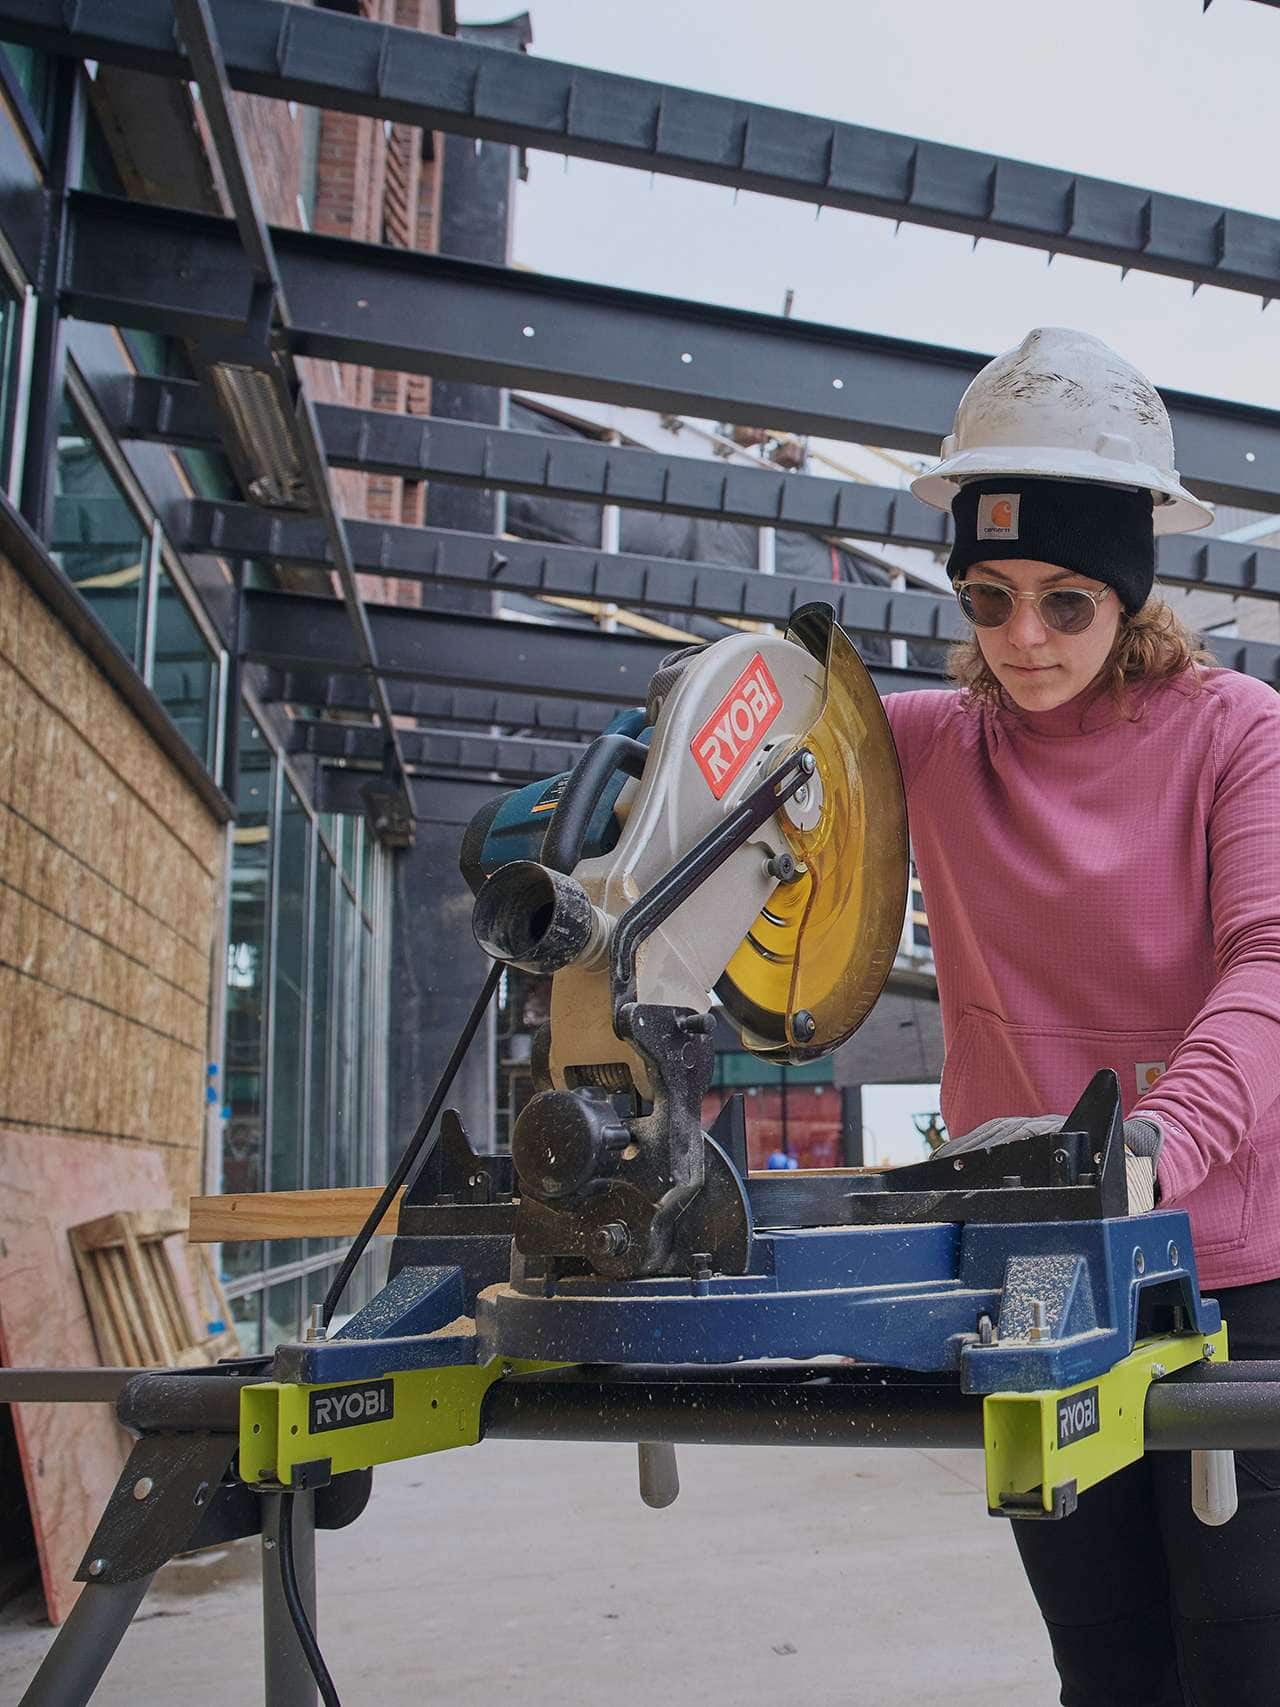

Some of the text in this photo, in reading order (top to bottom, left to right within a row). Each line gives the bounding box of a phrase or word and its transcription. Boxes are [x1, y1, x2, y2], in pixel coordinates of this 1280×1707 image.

[699, 669, 775, 784] RYOBI
[315, 1388, 385, 1425] RYOBI
[1060, 1396, 1095, 1438] RYOBI
